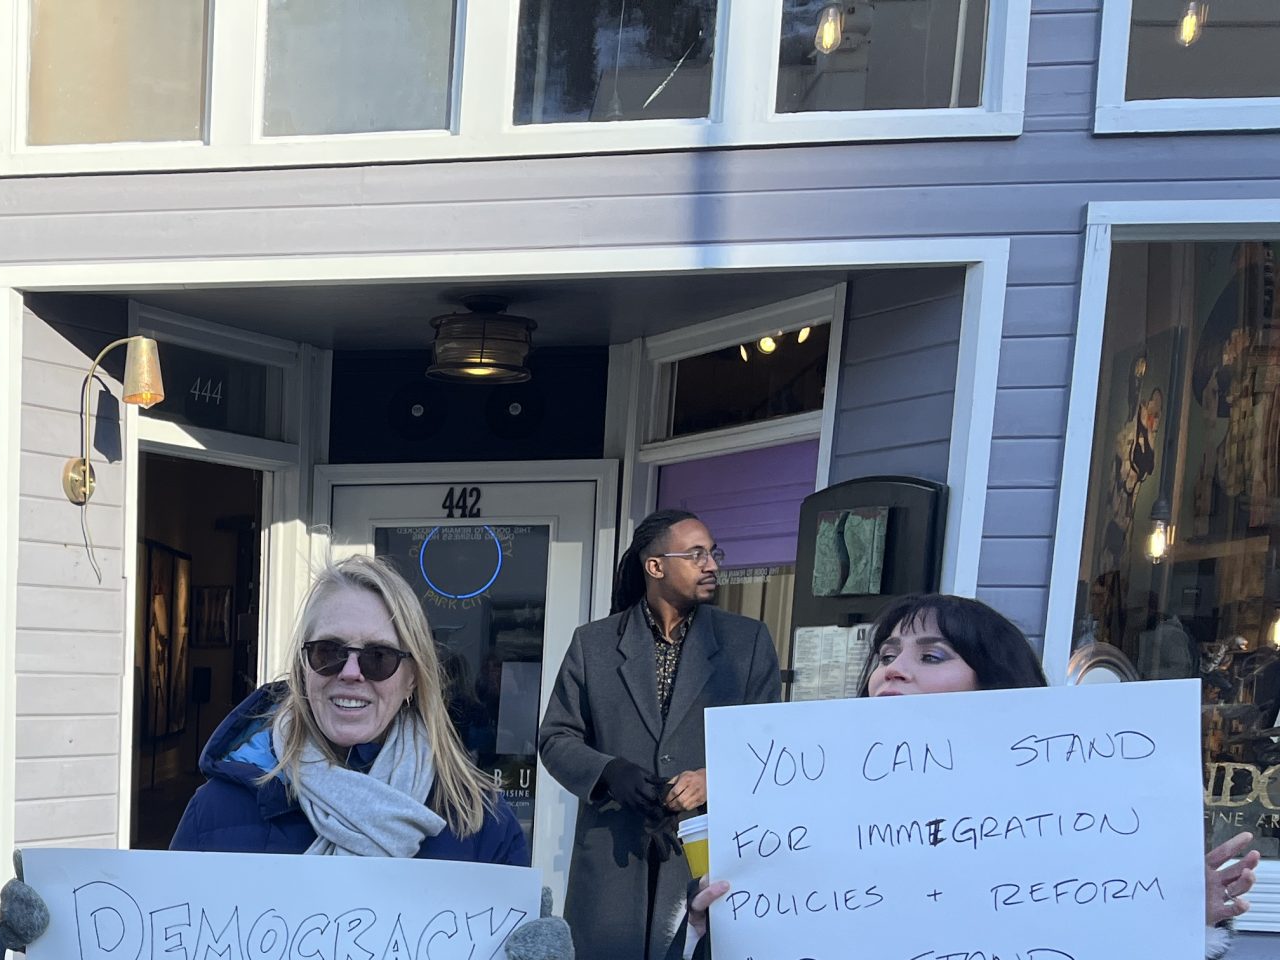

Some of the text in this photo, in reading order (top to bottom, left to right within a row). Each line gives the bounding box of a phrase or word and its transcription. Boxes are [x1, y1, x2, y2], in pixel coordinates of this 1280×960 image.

[190, 377, 222, 405] 444
[442, 487, 481, 518] 442
[747, 731, 1156, 794] YOU CAN STAND
[732, 825, 812, 860] FOR
[726, 877, 1165, 920] POLICIES + REFORM
